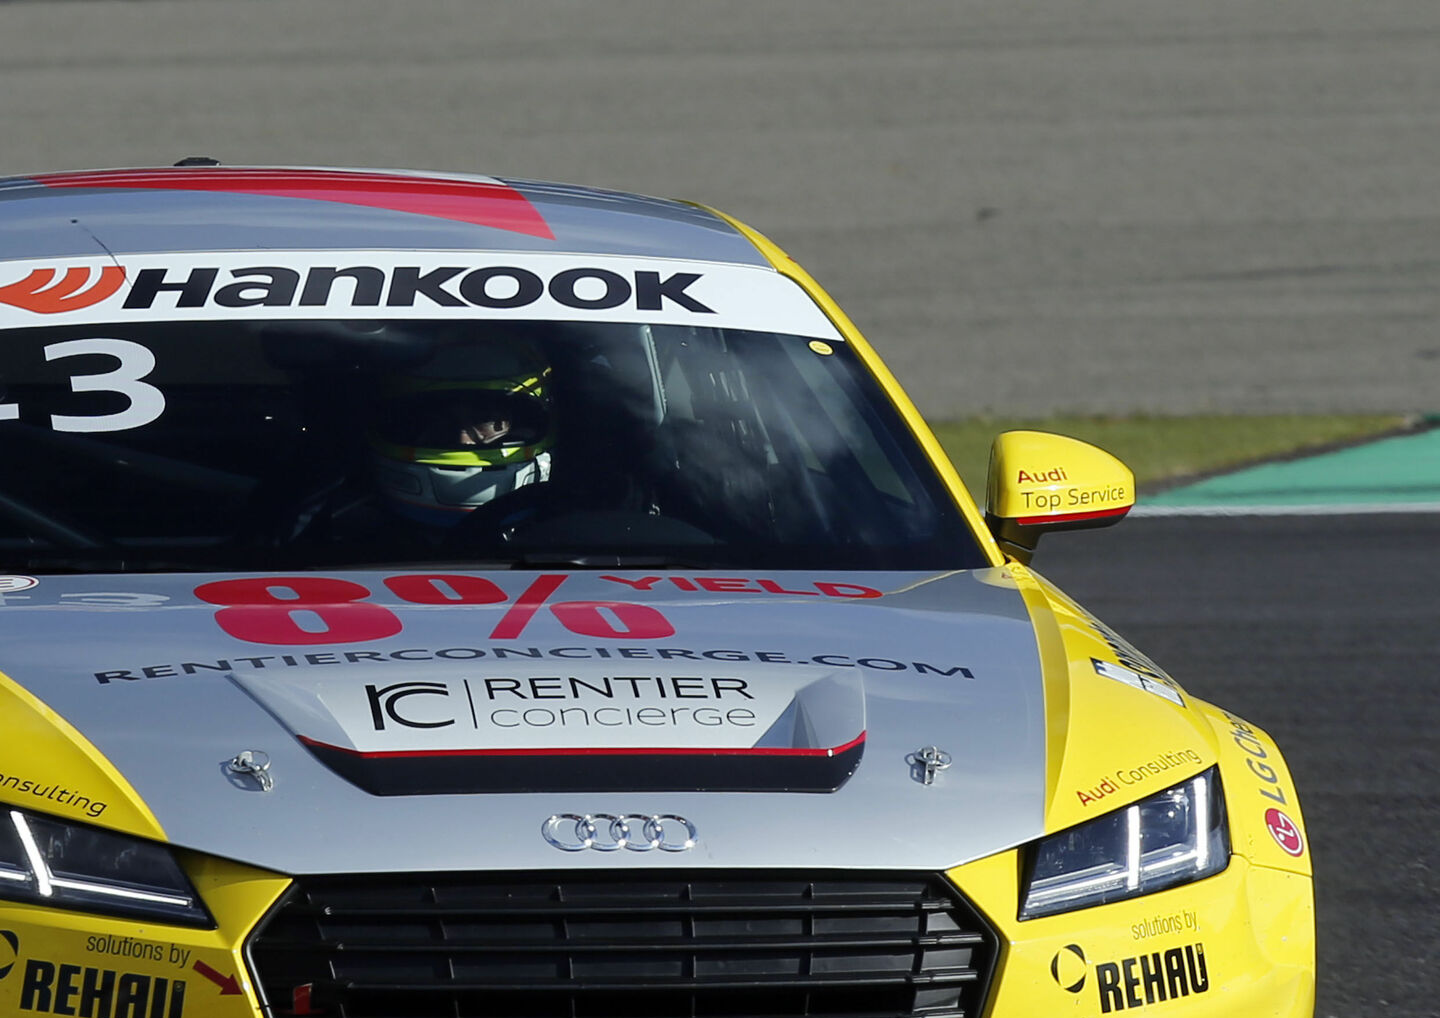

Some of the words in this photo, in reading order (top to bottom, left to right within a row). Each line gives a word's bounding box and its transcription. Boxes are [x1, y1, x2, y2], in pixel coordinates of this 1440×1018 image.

[1017, 467, 1068, 484] Audi
[1021, 491, 1062, 511] Top
[1068, 485, 1125, 506] Service
[598, 575, 884, 599] YIELD
[95, 646, 976, 686] RENTIERCONCIERGE.COM
[484, 677, 756, 700] RENTIER
[488, 701, 758, 730] concierge
[1076, 776, 1121, 807] Audi
[1116, 747, 1203, 786] Consulting
[1246, 757, 1287, 806] LG
[1131, 912, 1183, 941] solutions
[1183, 909, 1198, 933] by
[86, 934, 164, 962] solutions
[168, 943, 192, 969] by
[1095, 942, 1210, 1015] REHAU
